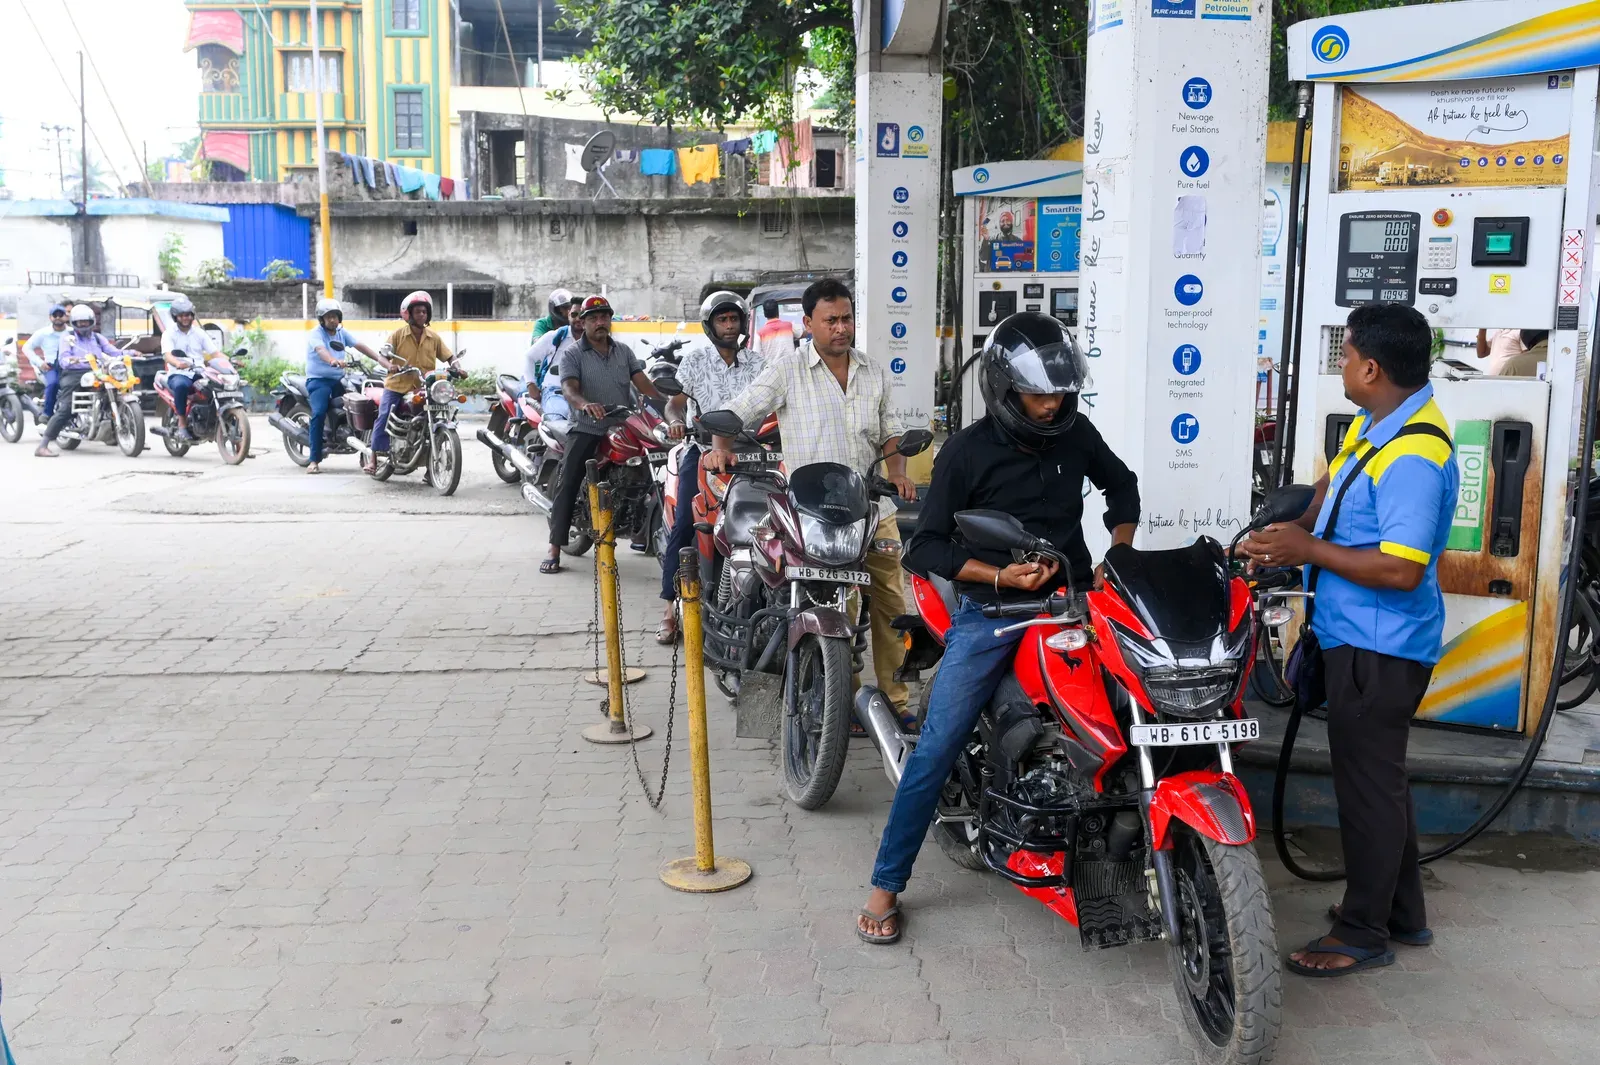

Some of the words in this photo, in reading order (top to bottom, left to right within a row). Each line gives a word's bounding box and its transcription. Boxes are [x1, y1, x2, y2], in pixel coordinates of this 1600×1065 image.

[1204, 3, 1249, 13] Petroleum
[1430, 89, 1449, 97] Desh
[1461, 88, 1480, 96] naye
[1481, 86, 1504, 94] future
[1436, 96, 1474, 104] khushiyon
[1178, 112, 1214, 123] New-age
[1427, 107, 1439, 124] Ab
[1442, 108, 1467, 124] future
[1470, 105, 1481, 120] ko
[1484, 103, 1501, 122] feel
[1171, 124, 1188, 133] Fuel
[1189, 124, 1220, 134] Stations
[1177, 180, 1194, 189] Pure
[1196, 180, 1210, 189] fuel
[1164, 308, 1213, 318] Tamper-proof
[1167, 321, 1209, 331] technology
[1167, 378, 1205, 389] Integrated
[1169, 390, 1204, 400] Payments
[1175, 449, 1193, 457] SMS
[1168, 461, 1199, 470] Updates
[1454, 451, 1482, 521] Petrol
[822, 503, 851, 512] HONDA
[1148, 512, 1175, 534] future
[1193, 507, 1212, 533] feel
[798, 568, 812, 578] WB
[844, 571, 870, 583] 3122
[1150, 727, 1169, 743] WB
[1181, 726, 1211, 742] 61C
[1221, 722, 1258, 740] 5198
